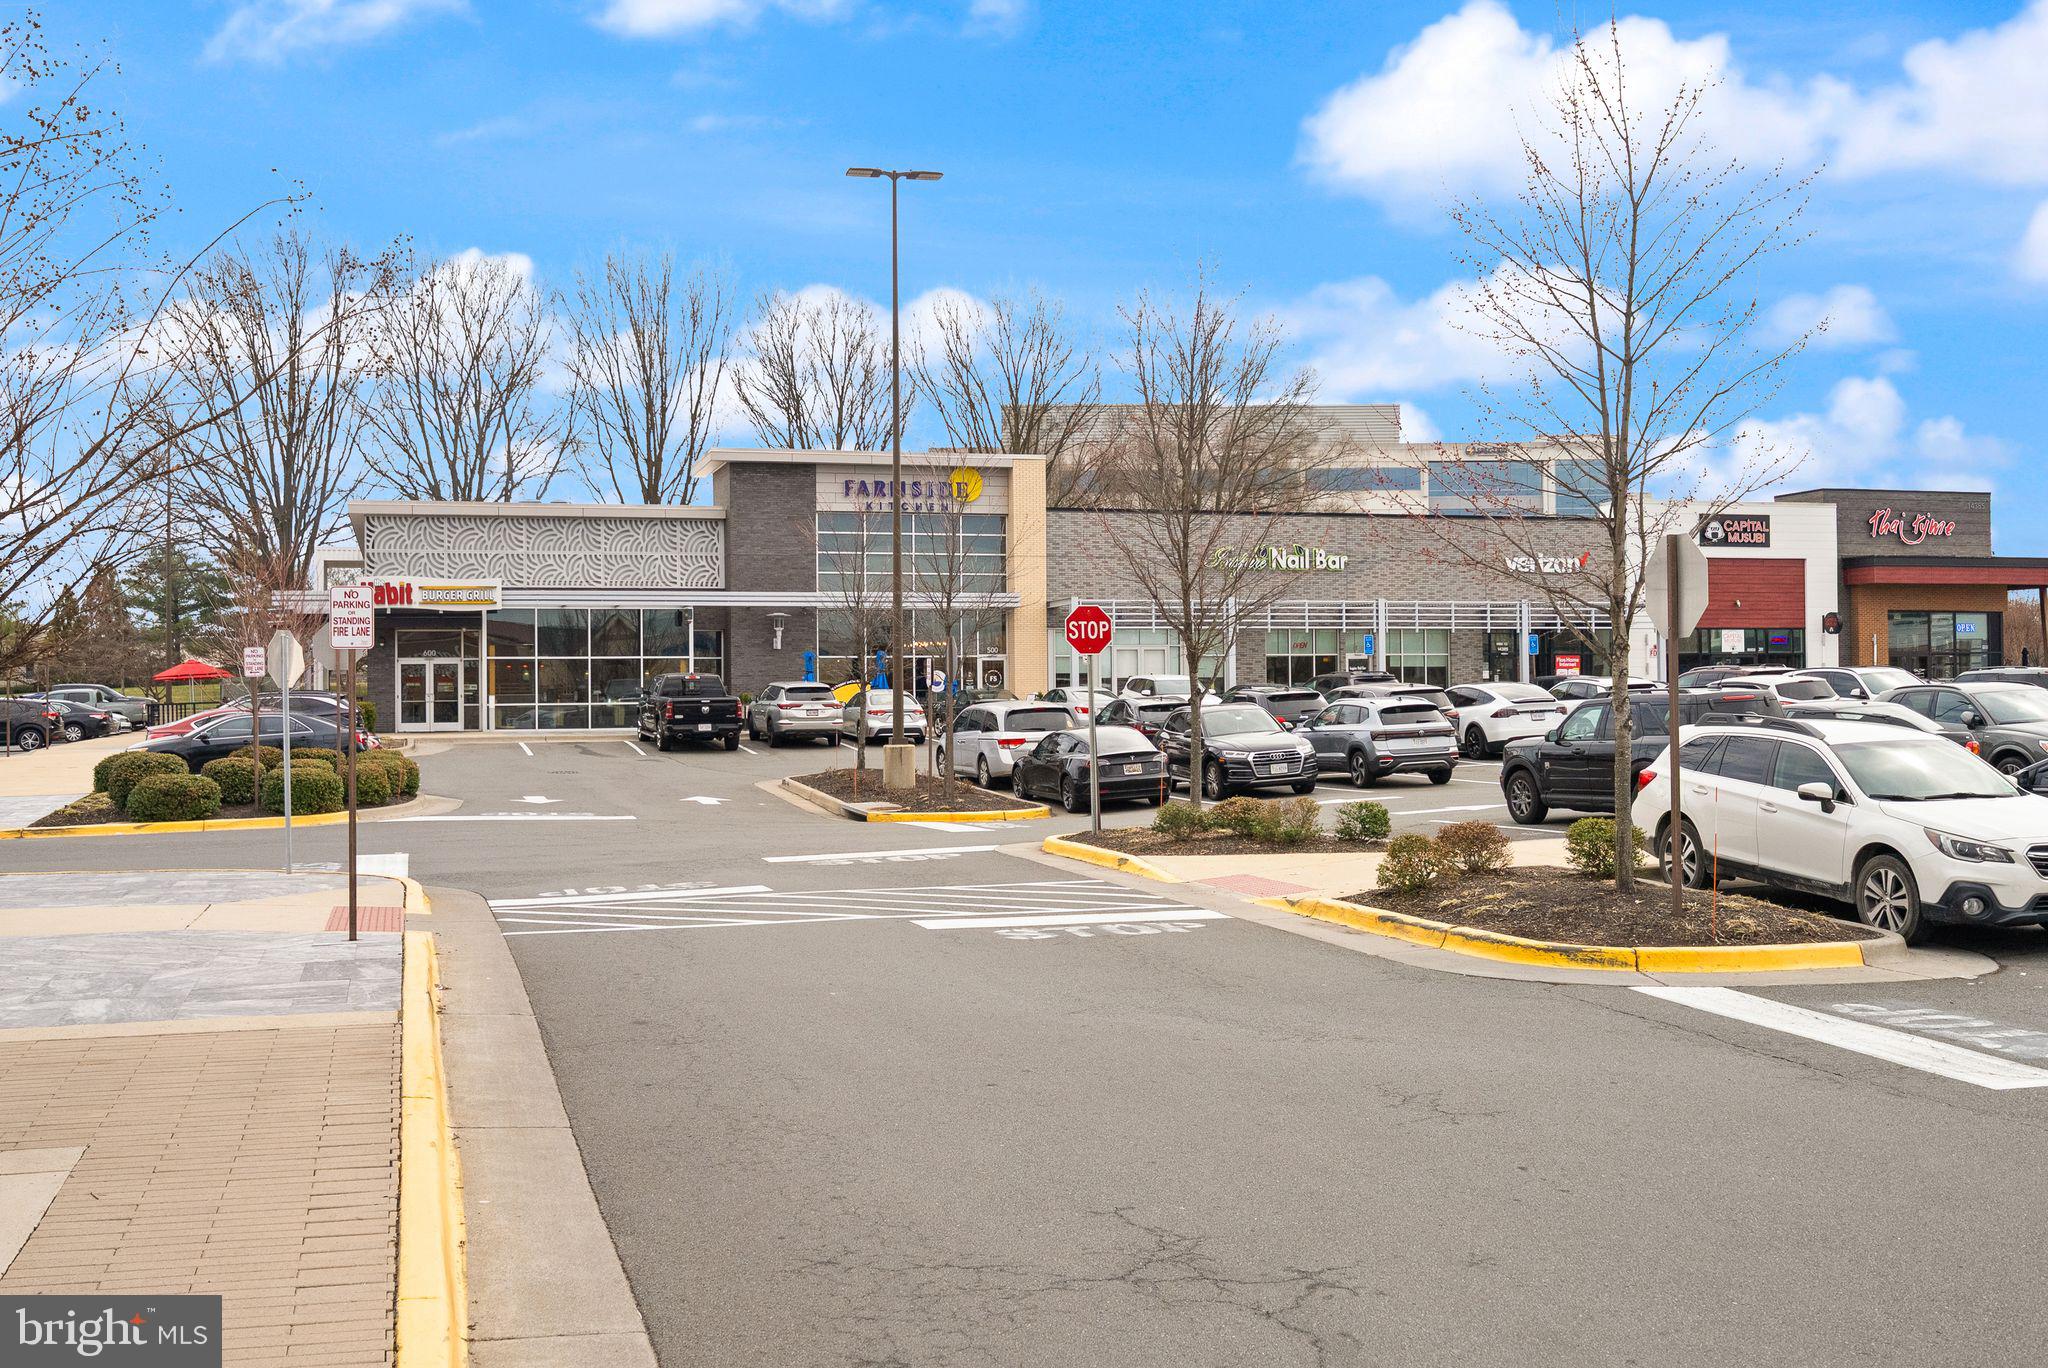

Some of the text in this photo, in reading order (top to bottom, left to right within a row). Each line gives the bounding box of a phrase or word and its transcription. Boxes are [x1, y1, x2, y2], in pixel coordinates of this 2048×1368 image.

[866, 501, 949, 511] KITCHEN
[1723, 519, 1770, 532] CAPITAL
[1869, 508, 1906, 541] Thai
[1727, 532, 1766, 543] MUSUBI
[1270, 544, 1310, 571] Nail
[1313, 549, 1348, 571] Bar
[1504, 552, 1581, 573] verizon
[344, 591, 359, 599] NO
[361, 582, 494, 605] abit BURGER GRILL
[333, 601, 370, 609] PARKING
[333, 617, 371, 625] STANDING
[333, 627, 371, 637] FIRE LANE
[1069, 621, 1109, 639] STOP
[1956, 623, 1977, 633] OPEN
[423, 649, 437, 657] 600
